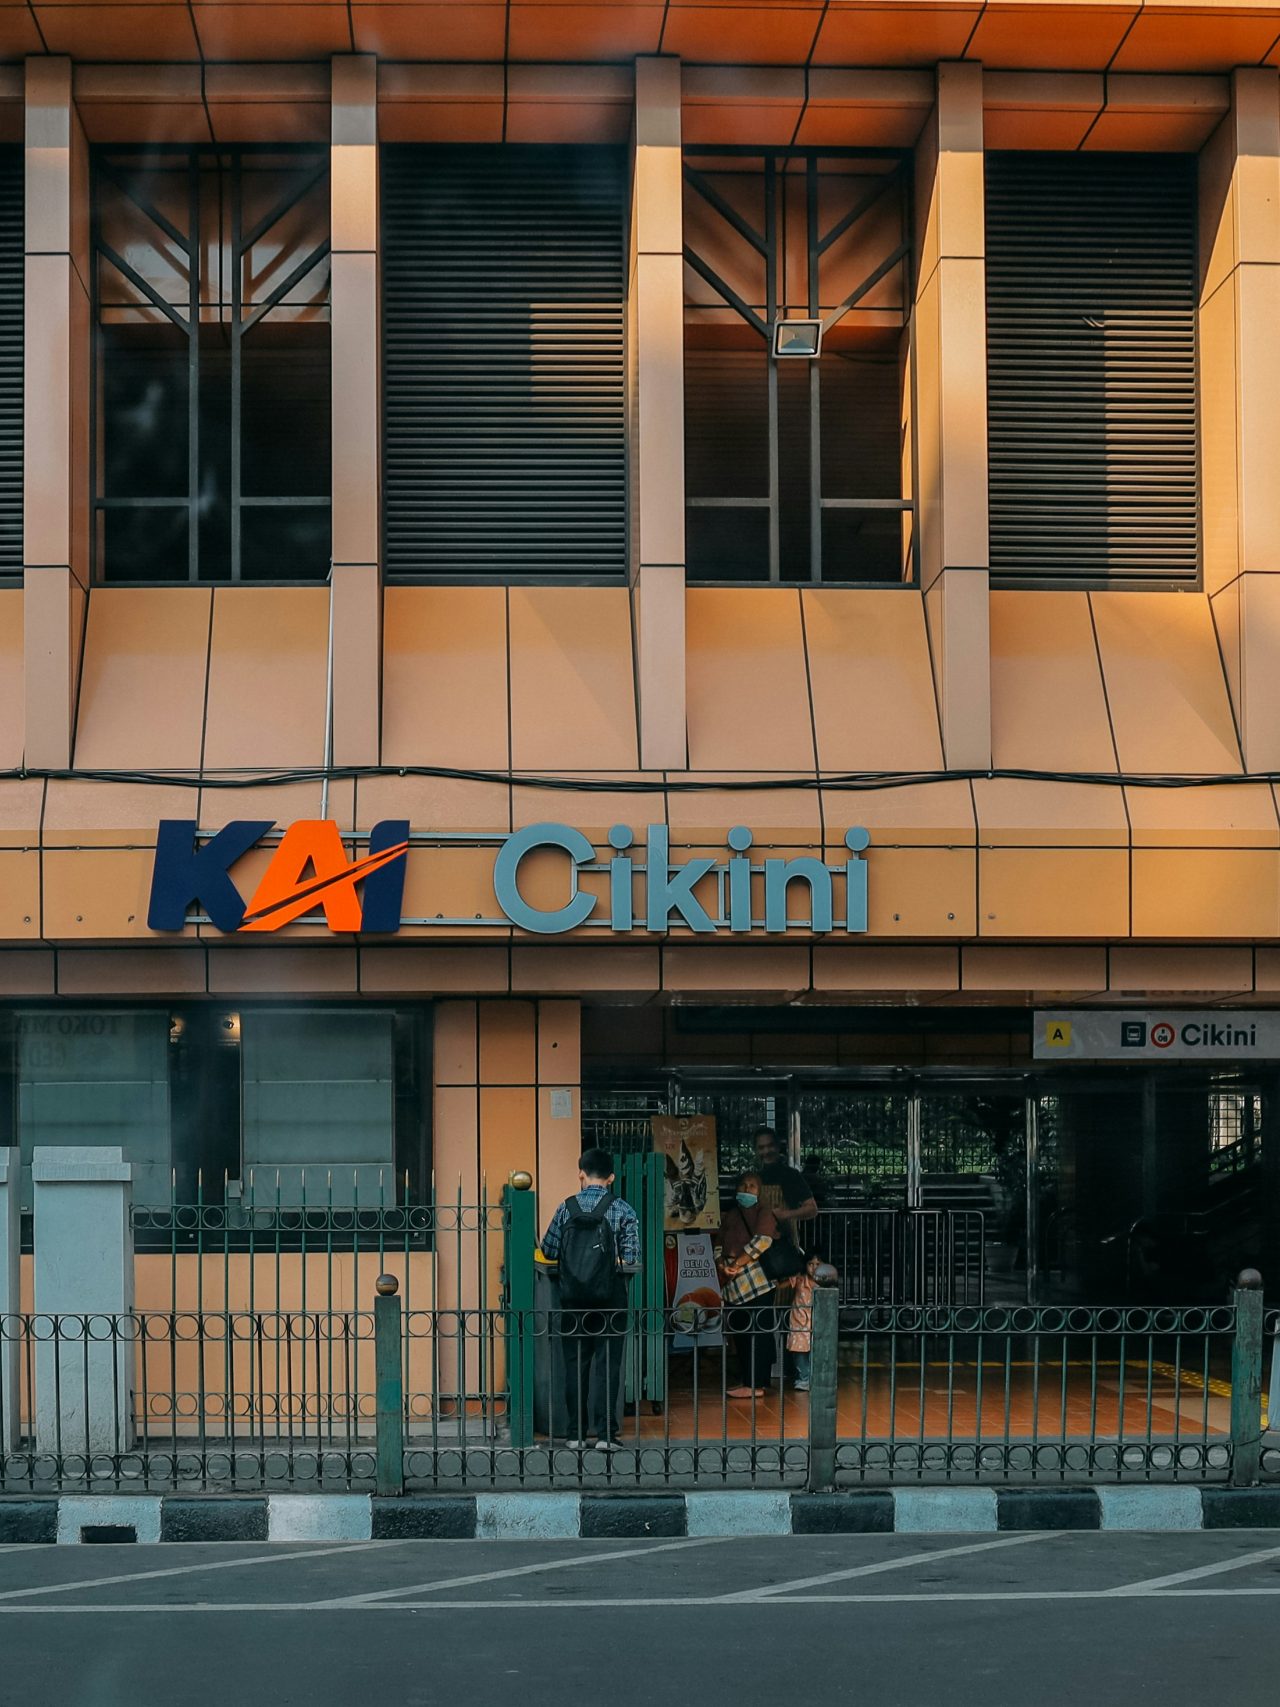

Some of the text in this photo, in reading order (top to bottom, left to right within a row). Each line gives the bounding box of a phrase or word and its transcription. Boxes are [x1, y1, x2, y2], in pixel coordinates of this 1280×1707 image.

[147, 819, 868, 934] KAI Cikini
[1052, 1028, 1064, 1040] A
[1181, 1024, 1256, 1046] Cikini
[684, 1259, 702, 1268] BELI
[680, 1269, 710, 1278] GRATIS
